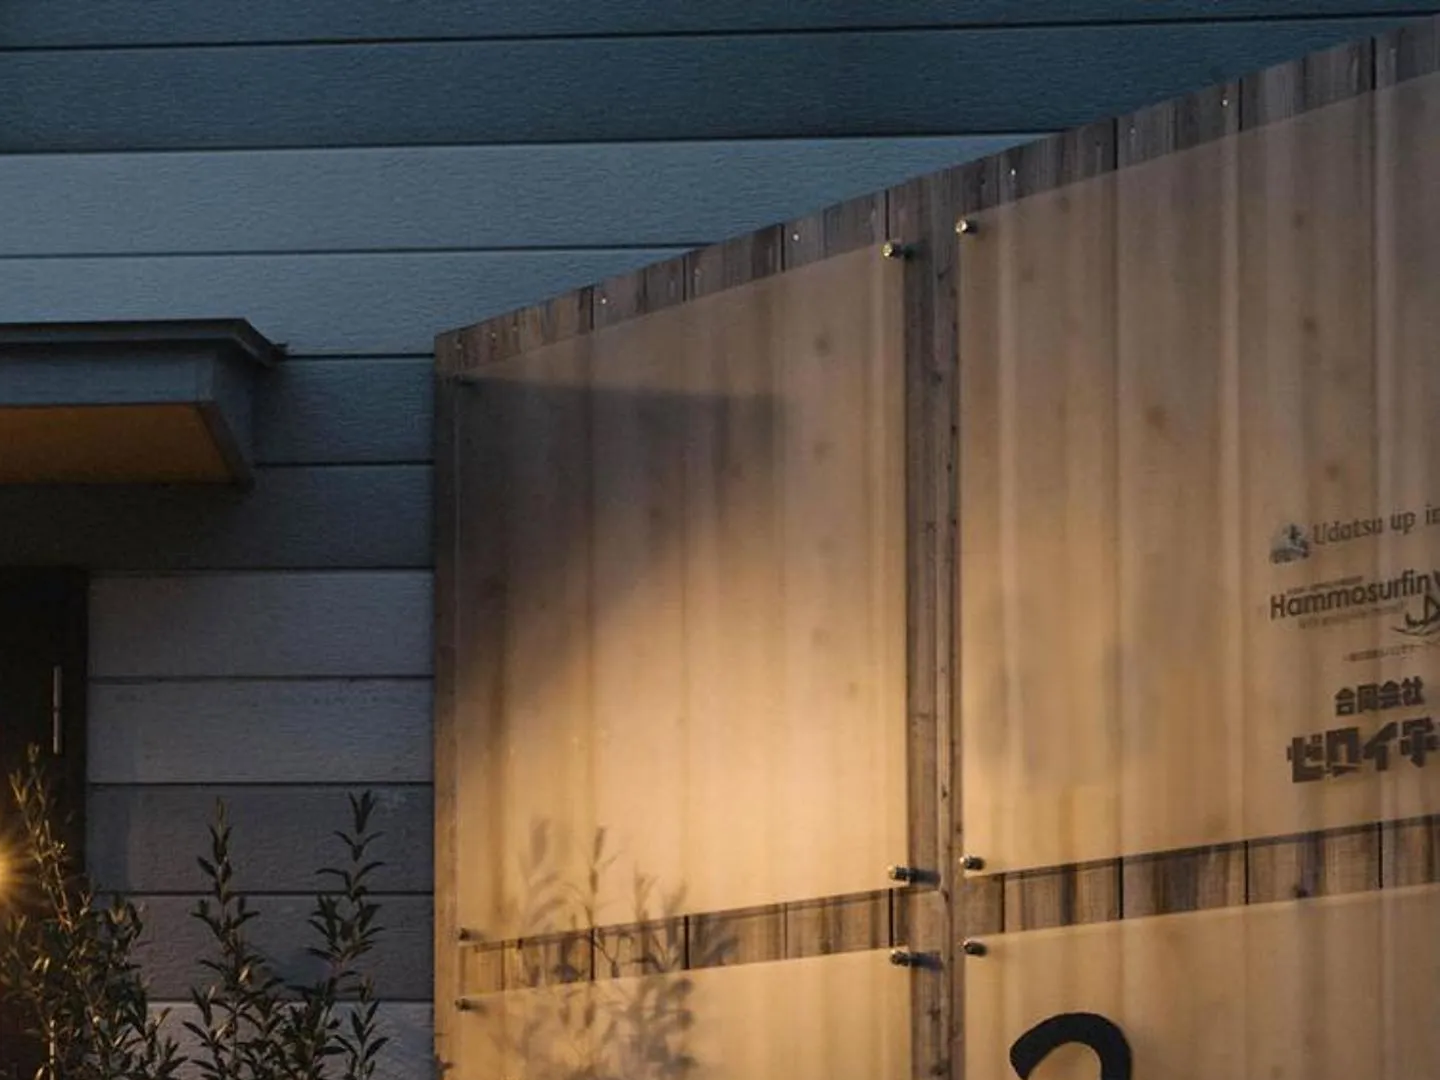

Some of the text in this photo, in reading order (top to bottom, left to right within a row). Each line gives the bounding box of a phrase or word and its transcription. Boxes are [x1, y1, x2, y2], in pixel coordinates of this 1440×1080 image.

[1313, 516, 1383, 546] Udatsu
[1335, 676, 1426, 716] 合同会社
